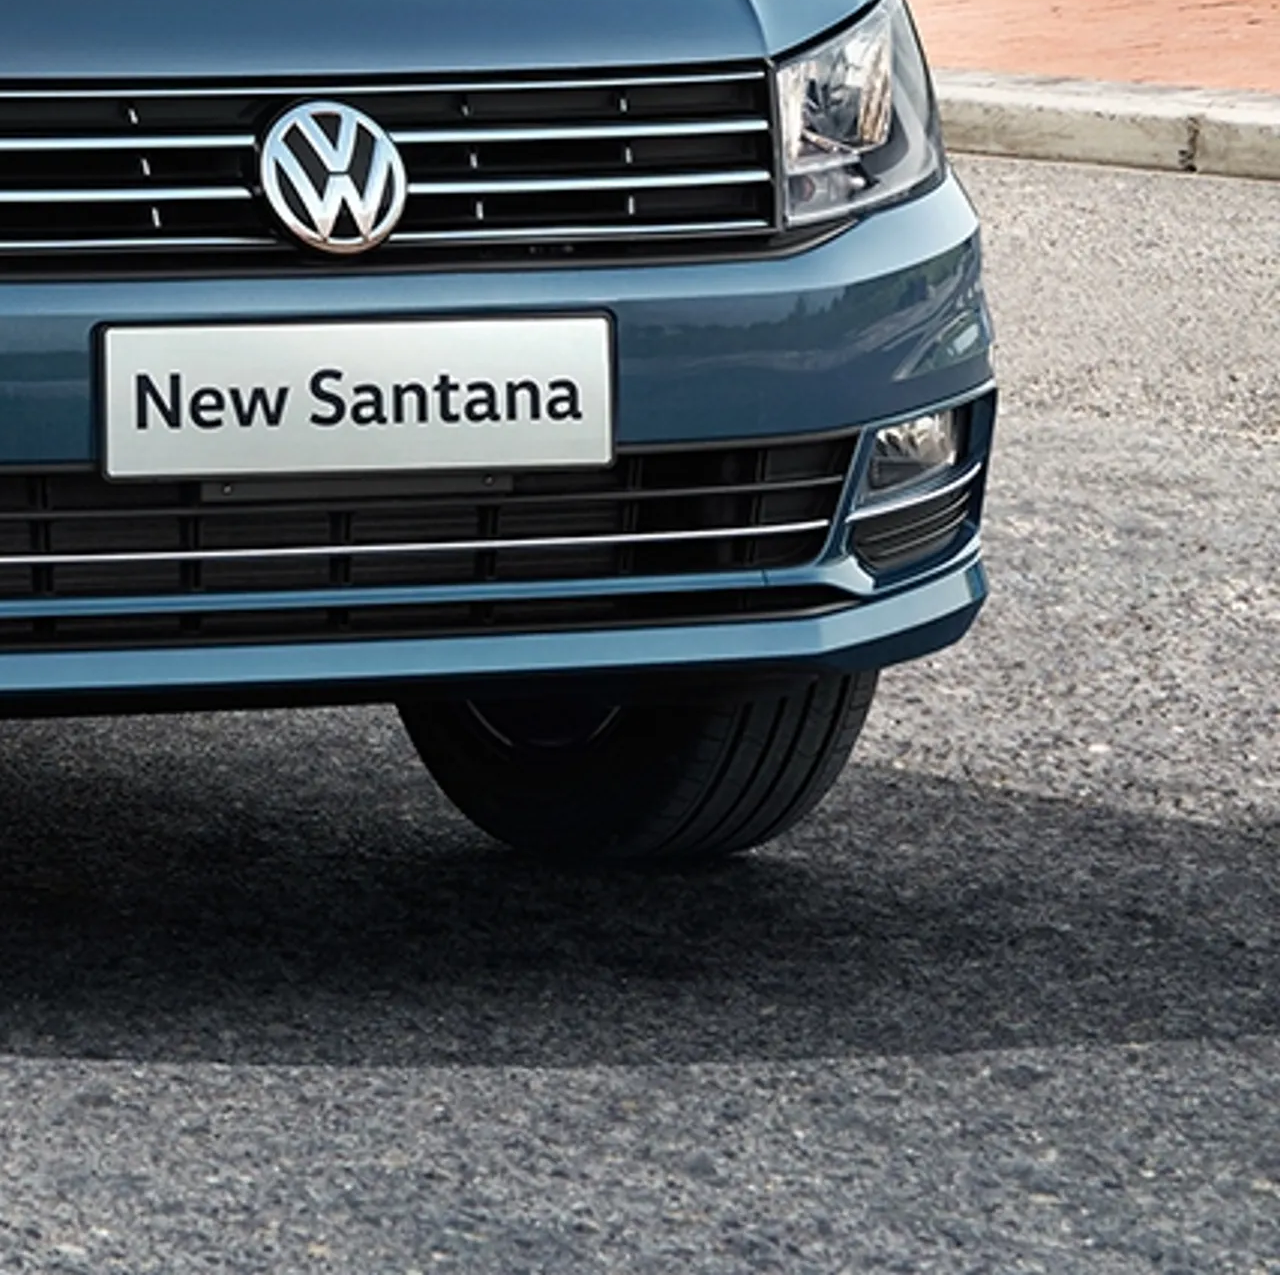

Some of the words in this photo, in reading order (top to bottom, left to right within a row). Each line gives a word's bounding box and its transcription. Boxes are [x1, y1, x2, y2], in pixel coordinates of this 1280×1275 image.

[261, 101, 408, 253] VW
[135, 373, 288, 429] New
[309, 369, 583, 426] Santana
